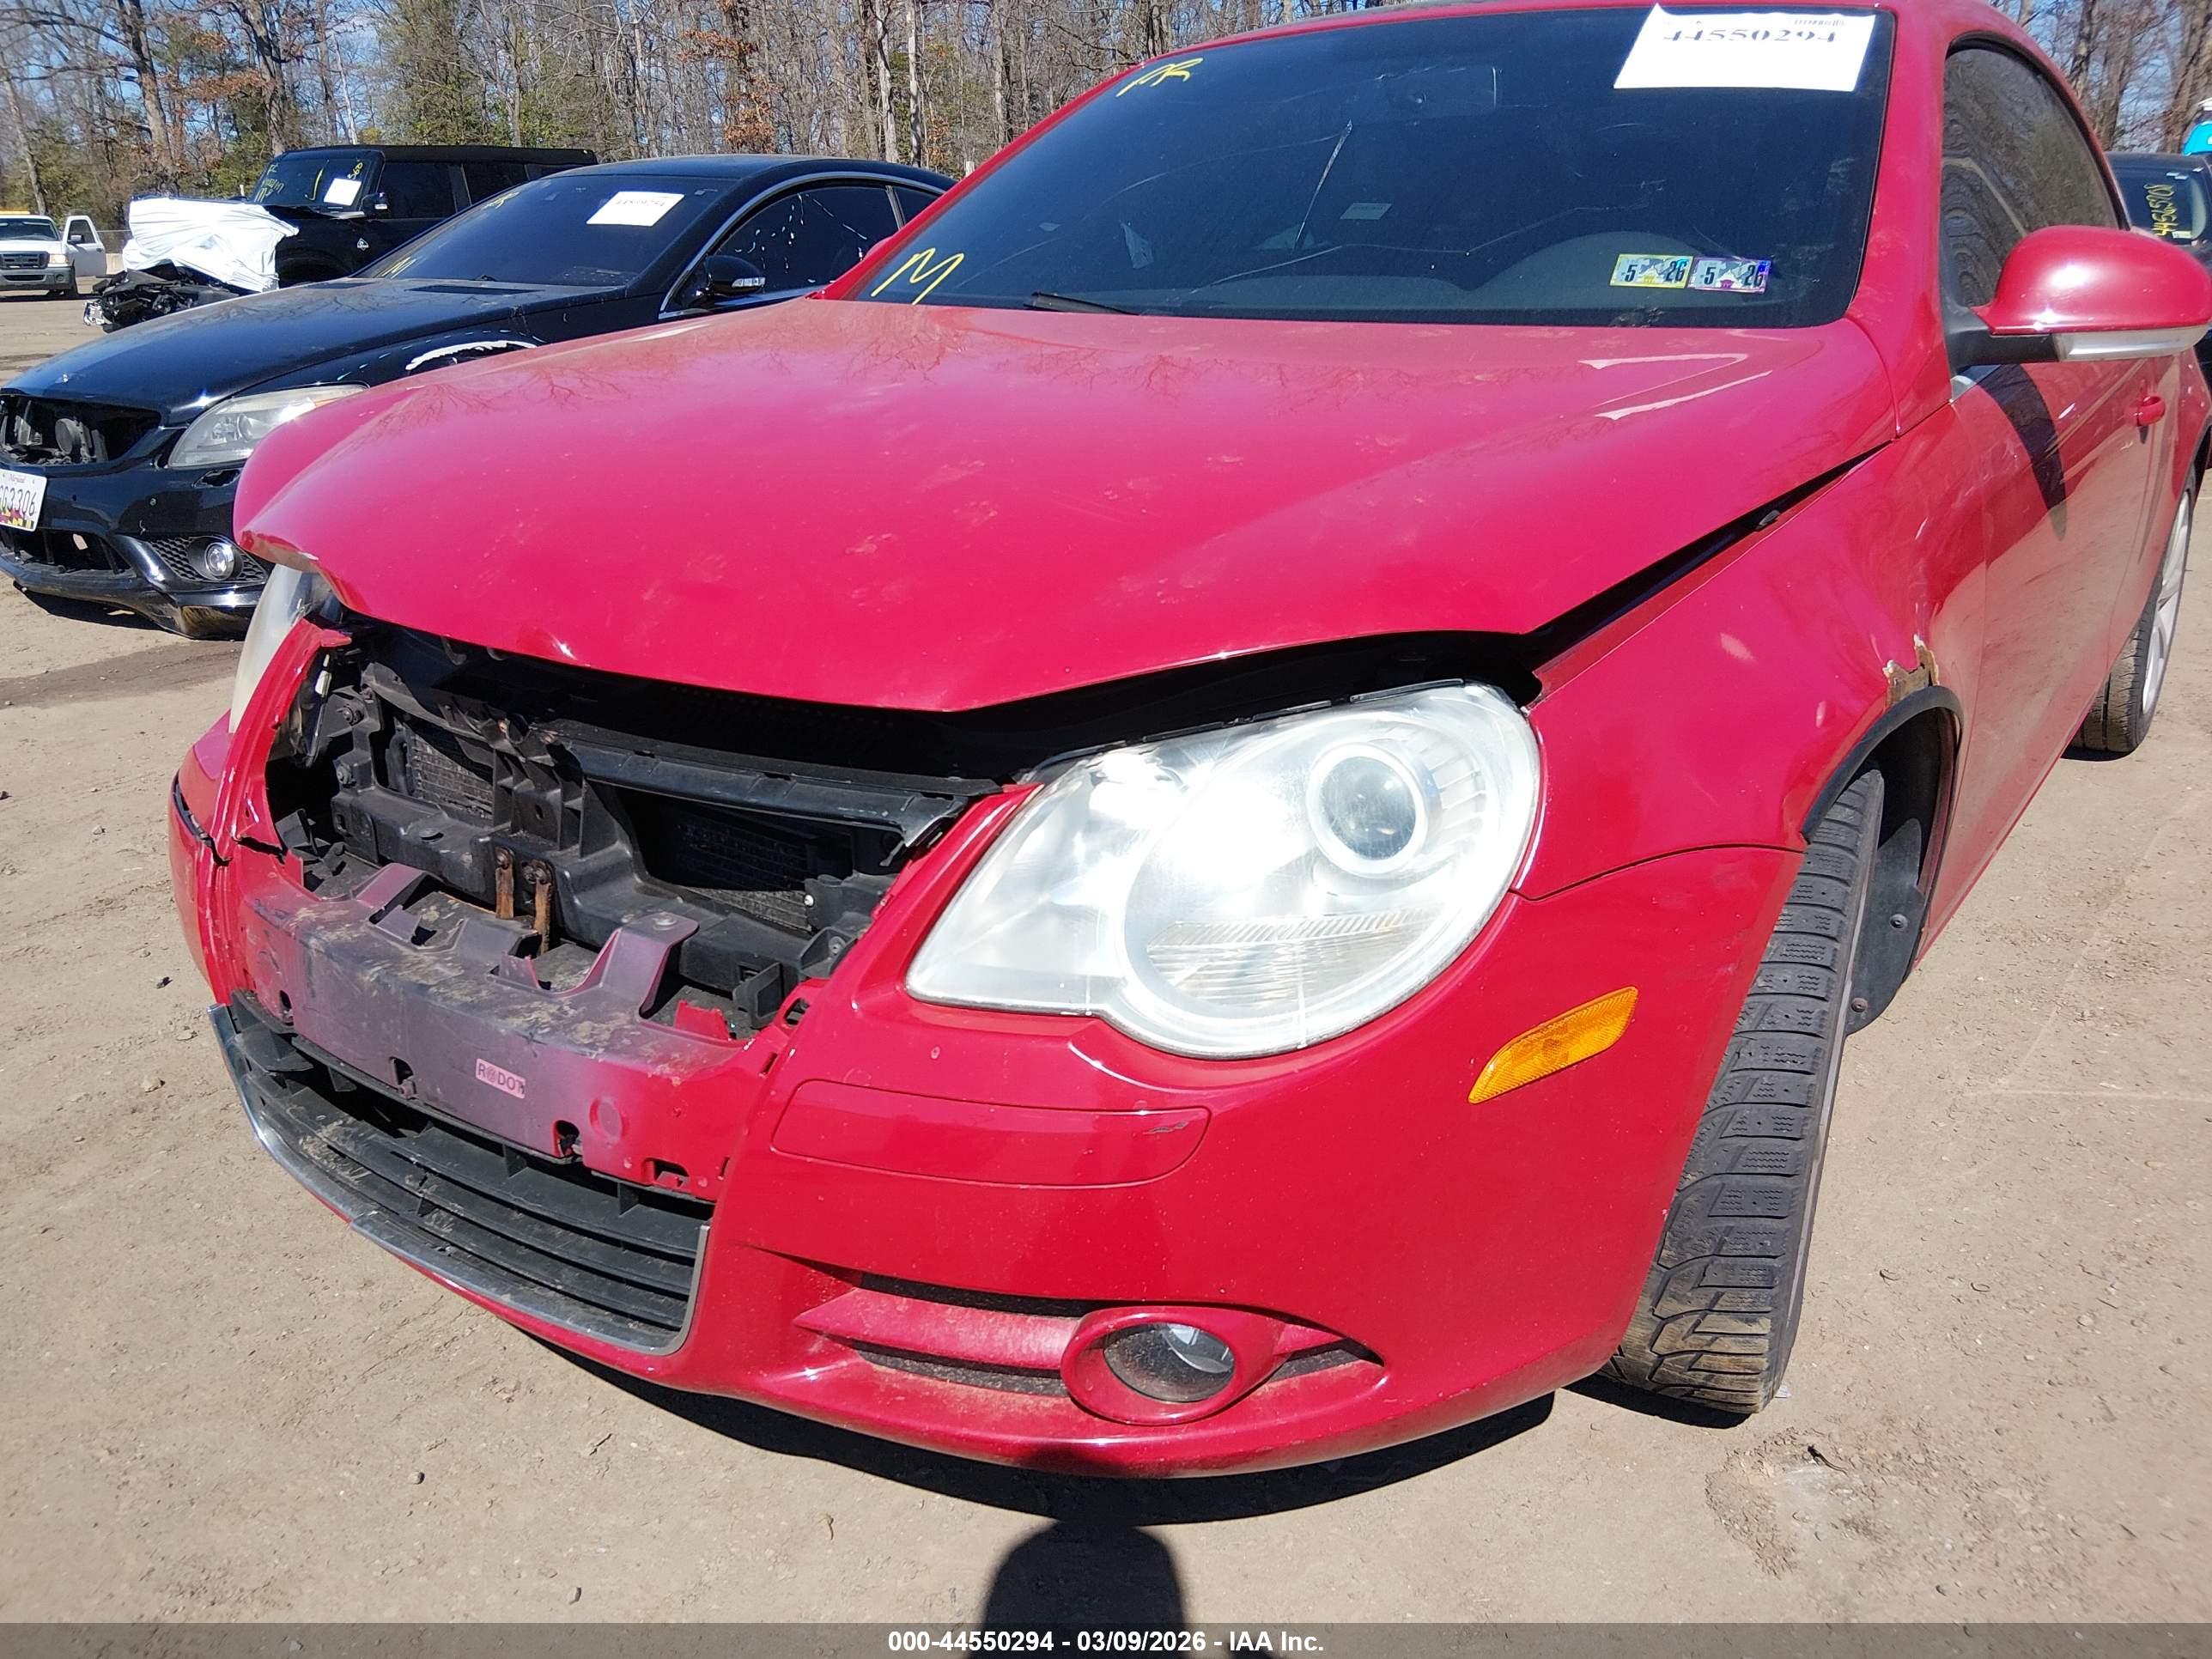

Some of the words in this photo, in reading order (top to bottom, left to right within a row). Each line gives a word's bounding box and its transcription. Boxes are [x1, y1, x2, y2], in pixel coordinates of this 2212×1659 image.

[1662, 28, 1837, 43] 44550294
[871, 247, 964, 305] M
[1624, 264, 1638, 282] 5
[1663, 260, 1687, 283] 26
[1704, 266, 1717, 285] 5
